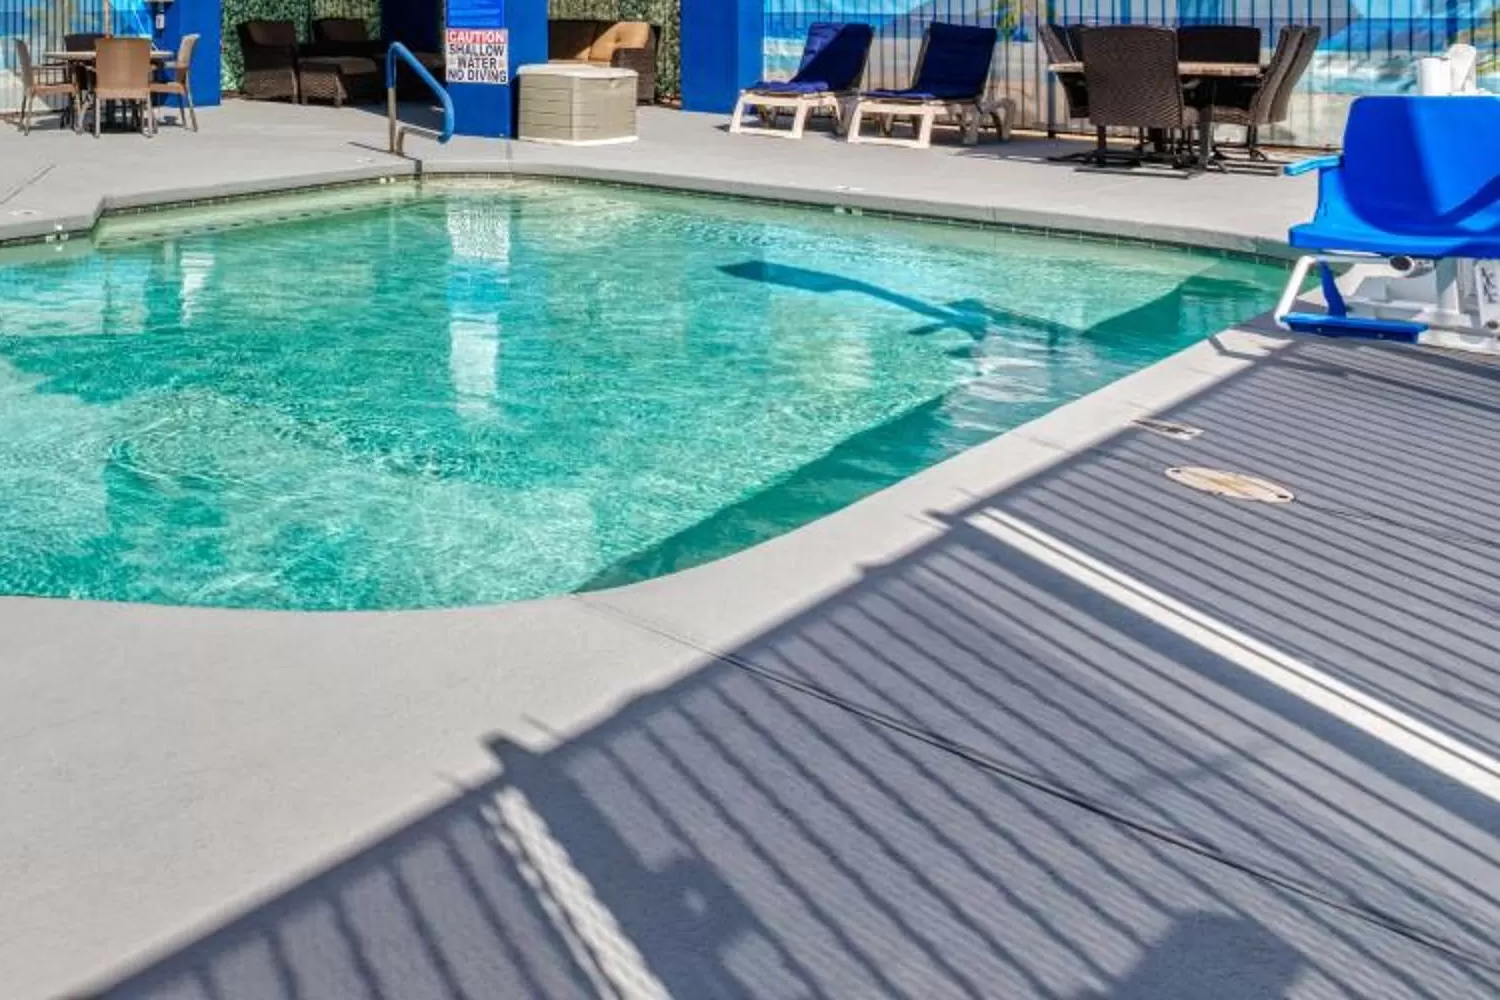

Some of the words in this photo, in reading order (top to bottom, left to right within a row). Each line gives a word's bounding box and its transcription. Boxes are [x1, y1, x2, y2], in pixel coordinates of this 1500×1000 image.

[449, 31, 505, 43] CAUTION
[449, 44, 504, 57] SHALLOW
[457, 57, 497, 69] WATER
[448, 69, 465, 81] NO
[467, 69, 507, 82] DIVING
